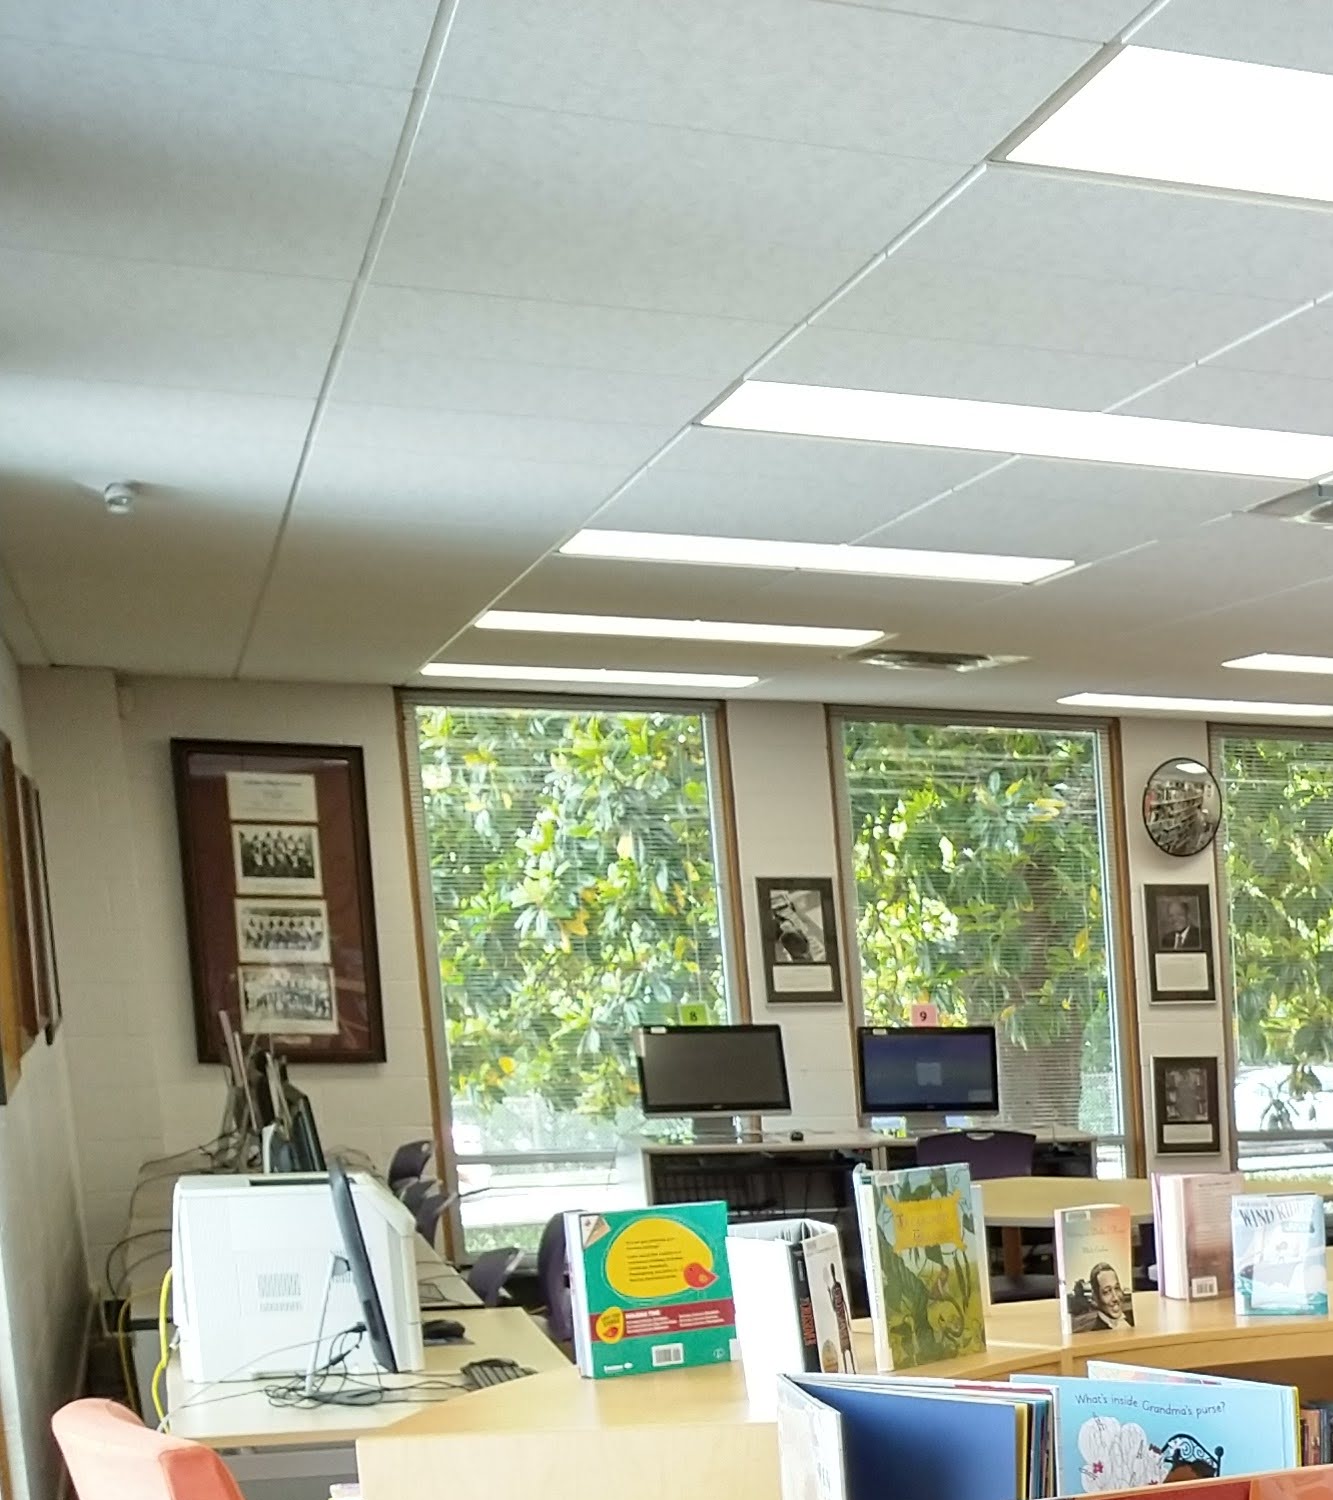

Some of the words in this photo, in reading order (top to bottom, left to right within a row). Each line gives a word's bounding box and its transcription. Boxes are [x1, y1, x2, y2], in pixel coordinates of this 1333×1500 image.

[1239, 1209, 1275, 1228] WIND
[1075, 1393, 1108, 1405] What's
[1111, 1396, 1138, 1408] inside
[1142, 1400, 1193, 1416] Grandma's
[1195, 1401, 1226, 1419] purse?
